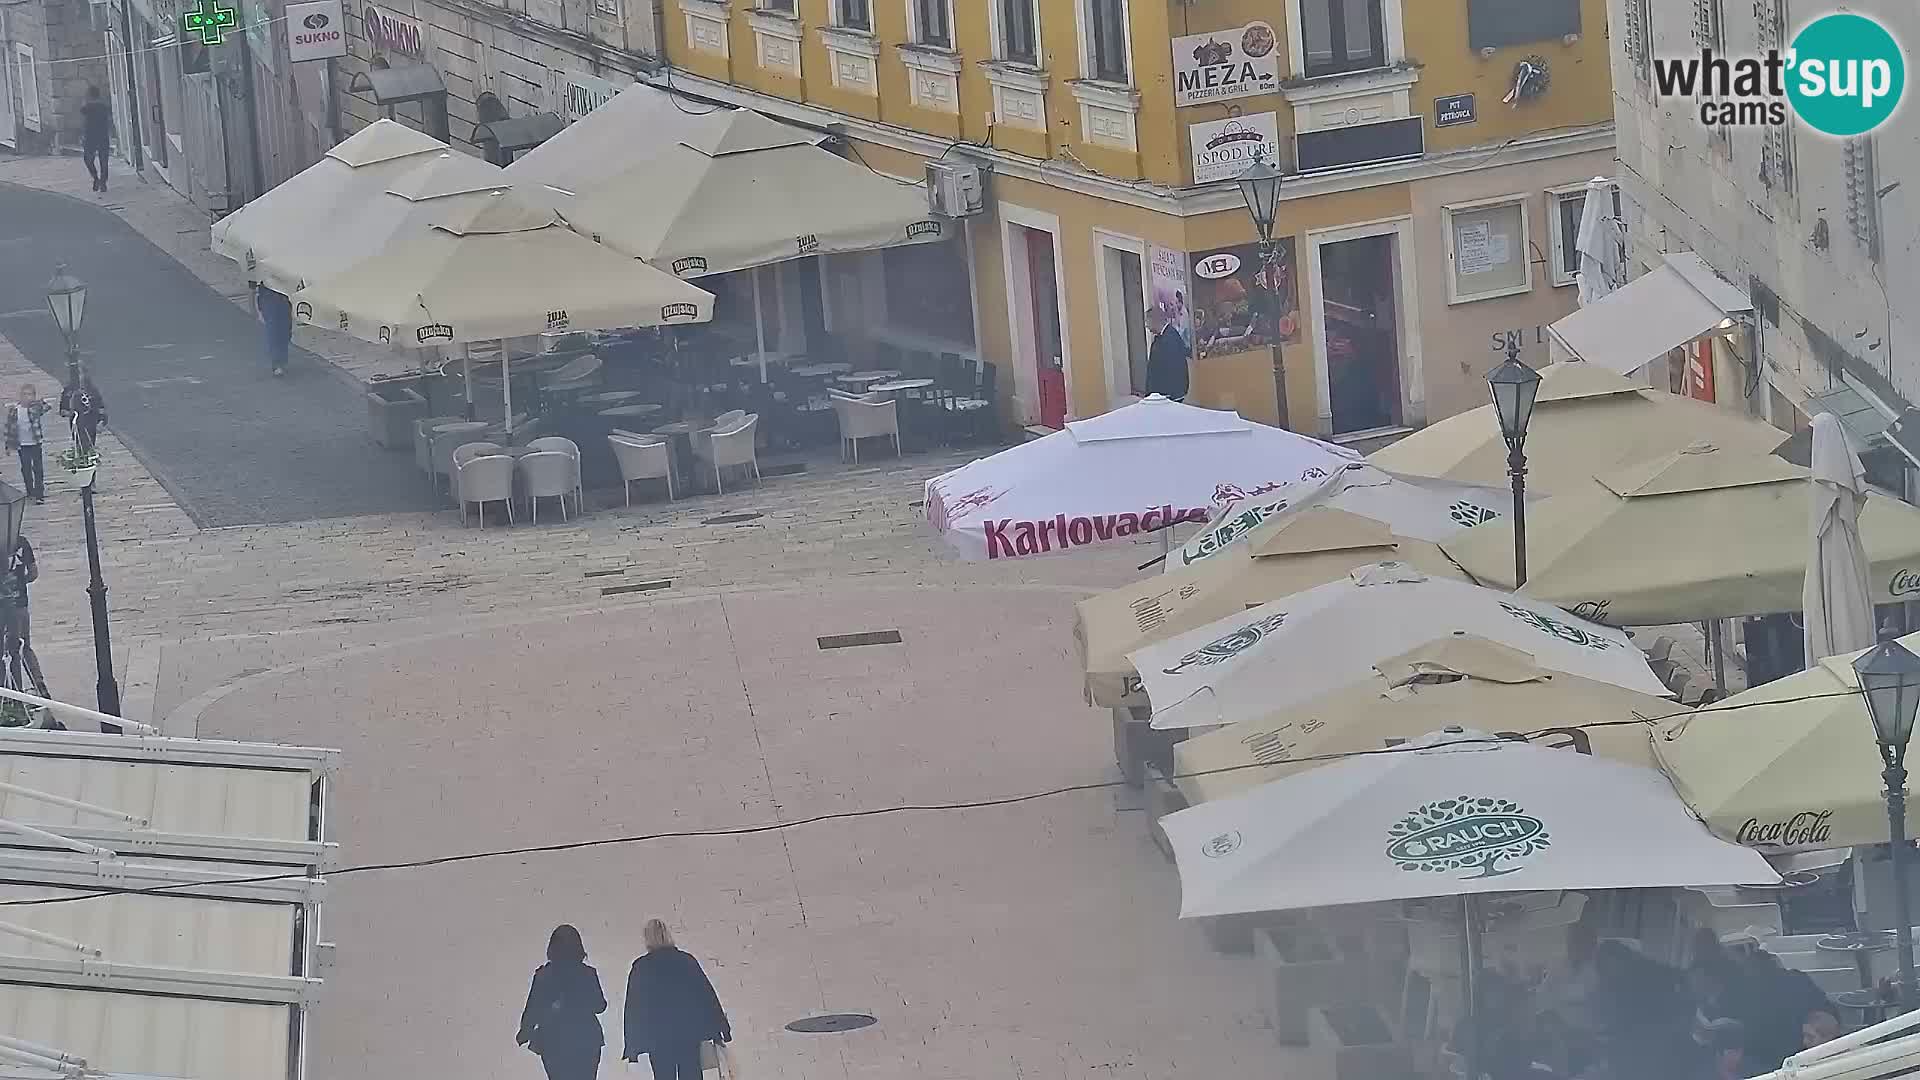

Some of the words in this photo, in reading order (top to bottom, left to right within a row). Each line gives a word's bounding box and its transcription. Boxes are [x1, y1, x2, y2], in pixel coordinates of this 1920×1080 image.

[296, 31, 340, 44] SUKNO
[381, 15, 421, 54] SUKNO
[1178, 62, 1257, 92] MEZA
[1187, 87, 1220, 100] PIZZERIA
[1228, 83, 1249, 94] GRILL
[1196, 147, 1242, 166] ISPOD
[1425, 820, 1526, 851] RAUCH
